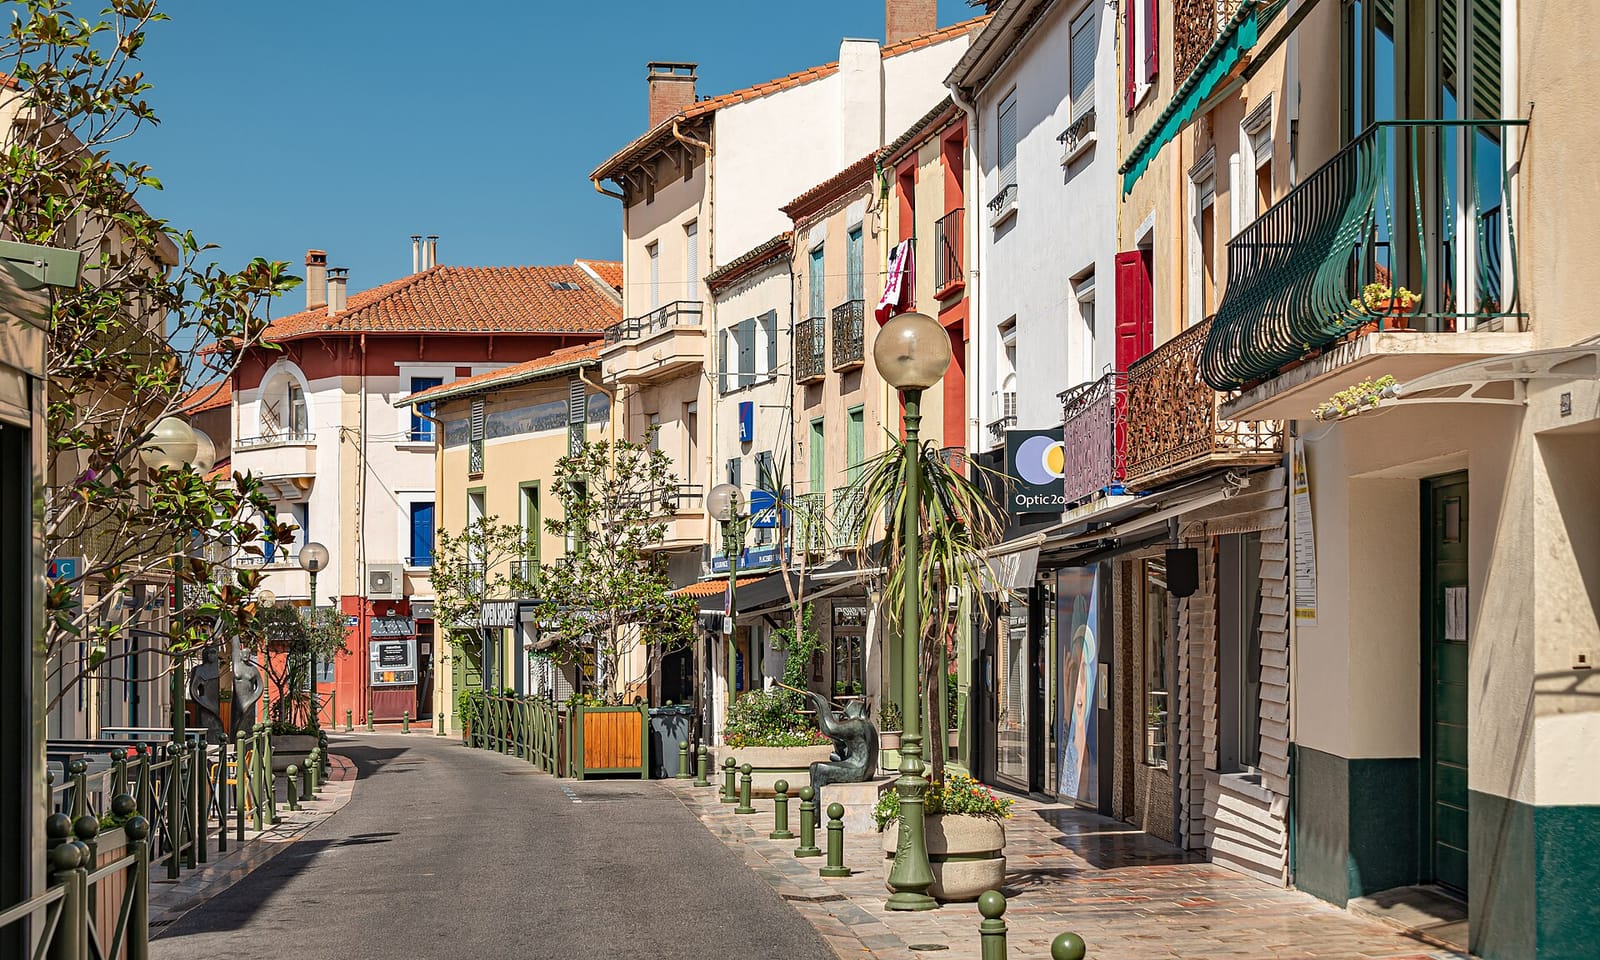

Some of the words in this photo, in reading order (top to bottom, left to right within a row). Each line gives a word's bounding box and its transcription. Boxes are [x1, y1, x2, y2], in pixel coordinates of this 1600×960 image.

[1015, 494, 1049, 508] Optic
[482, 602, 497, 626] OPEN
[497, 602, 516, 626] SHOES
